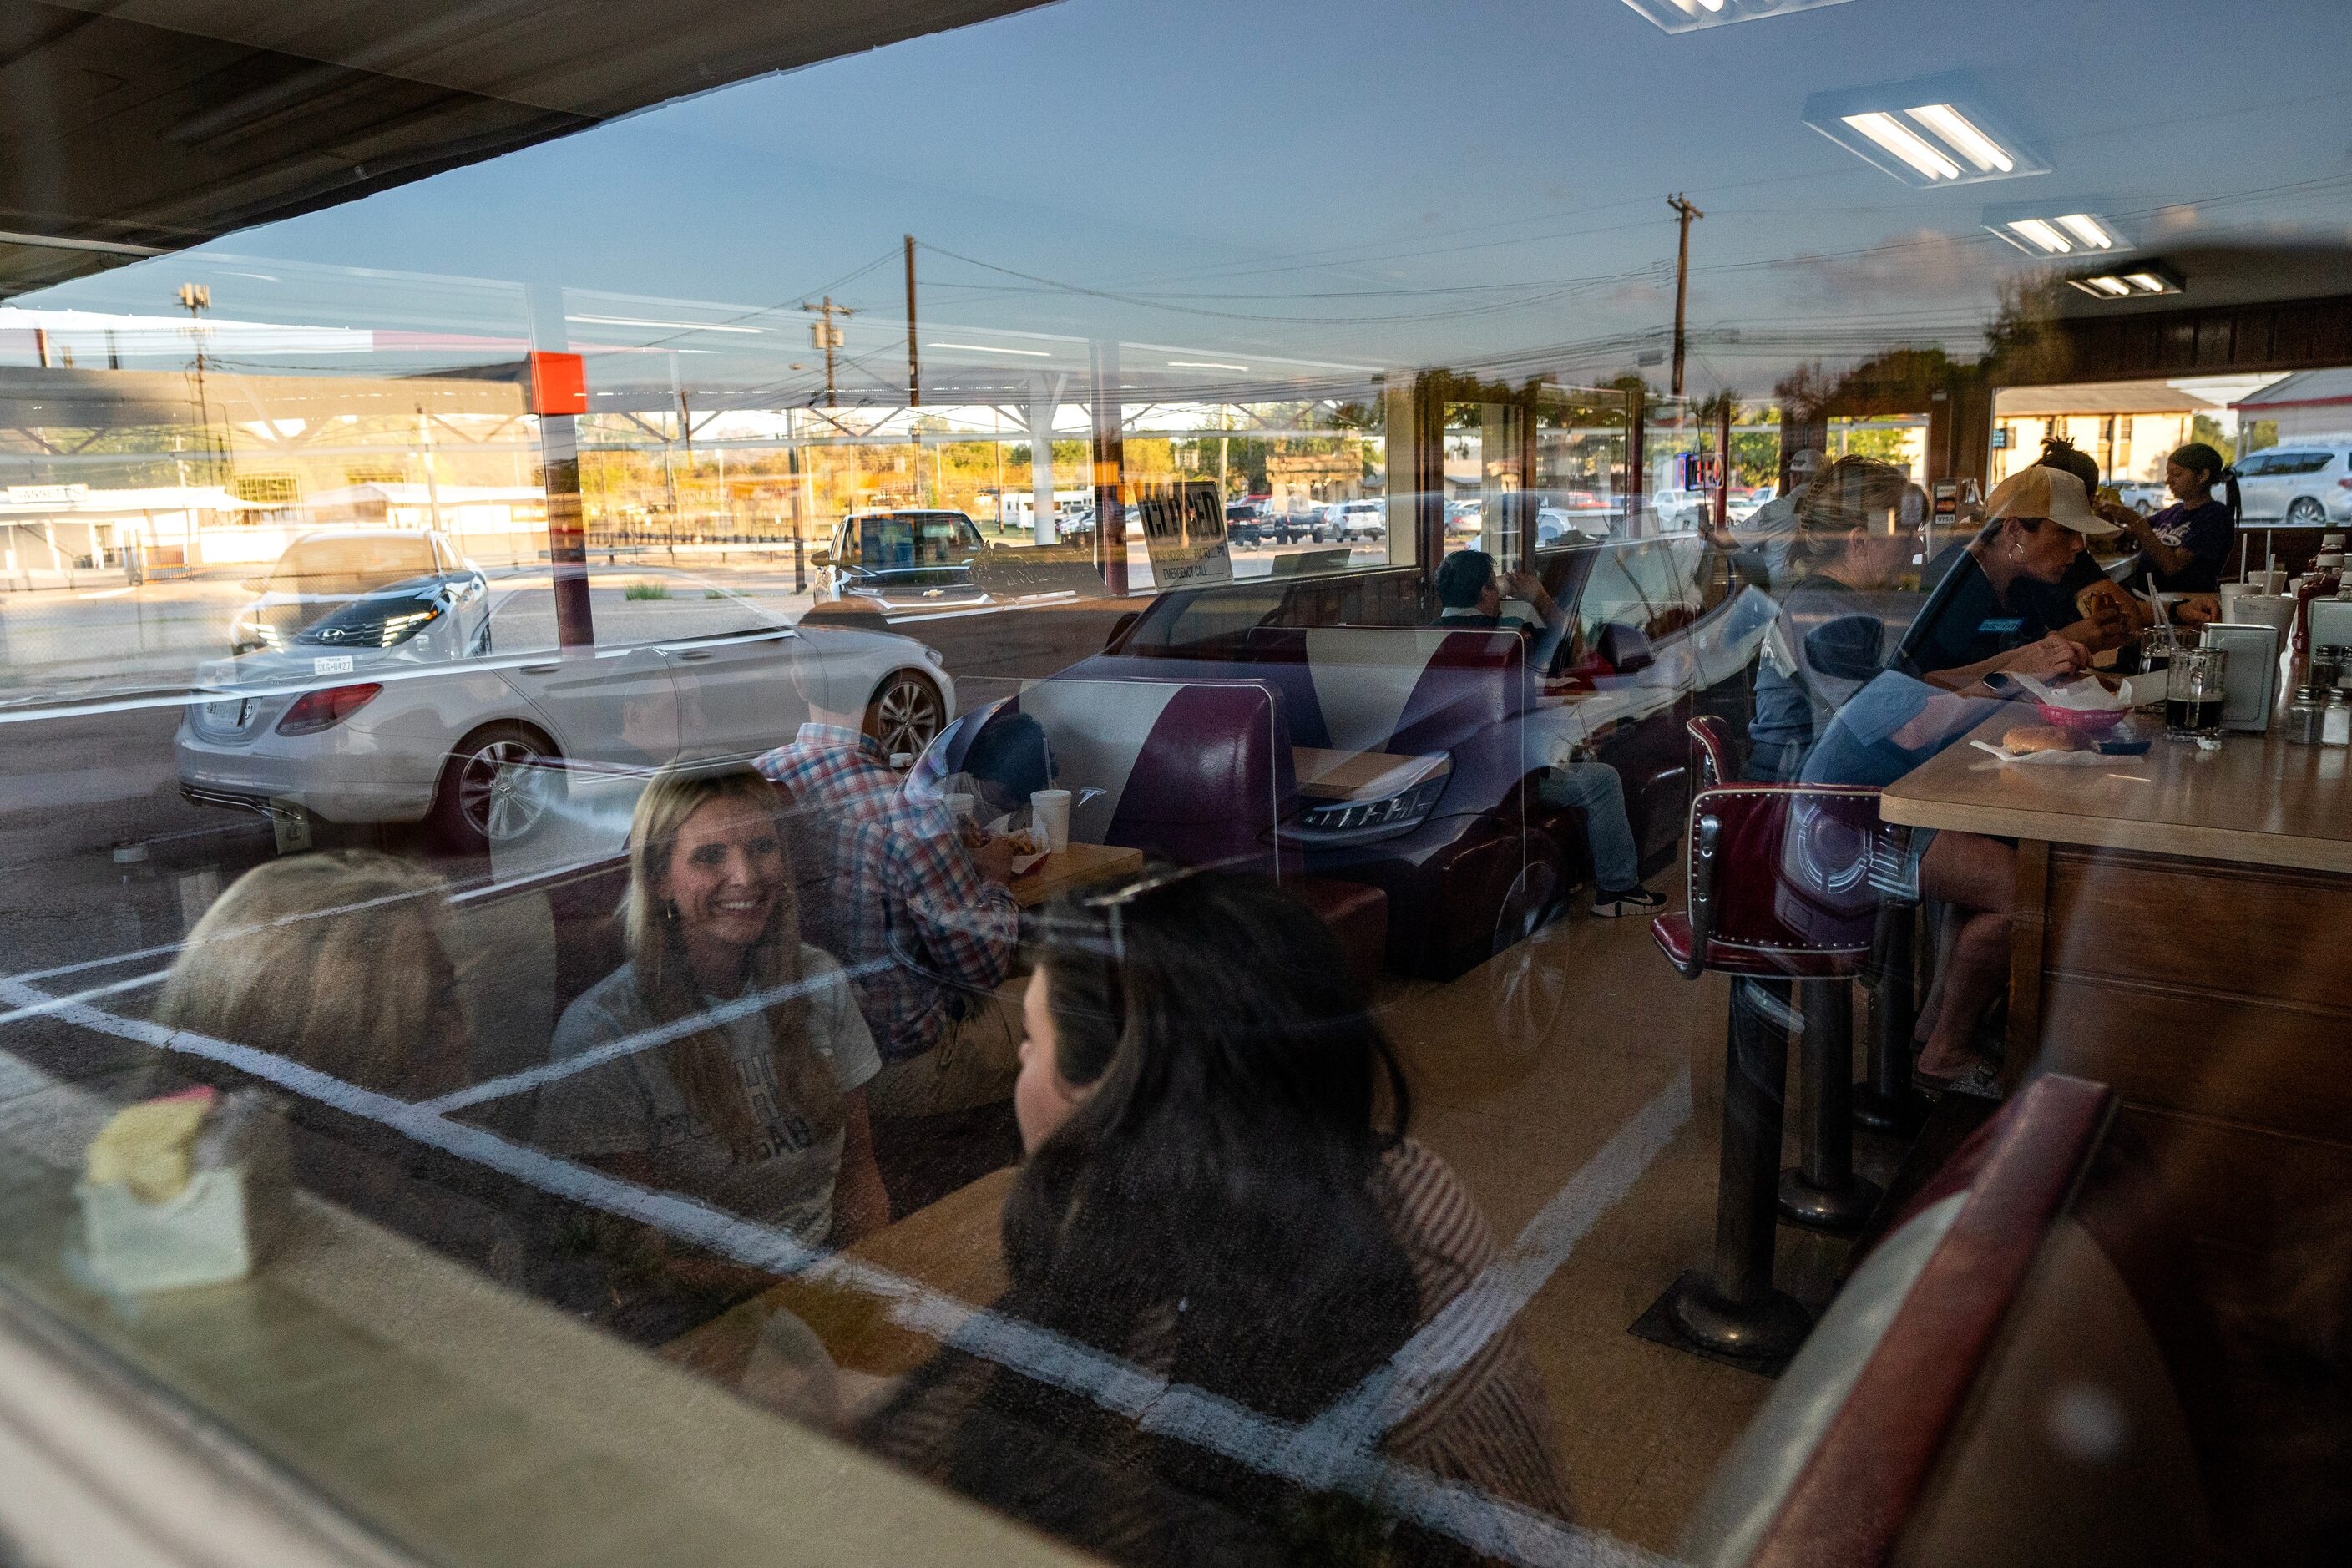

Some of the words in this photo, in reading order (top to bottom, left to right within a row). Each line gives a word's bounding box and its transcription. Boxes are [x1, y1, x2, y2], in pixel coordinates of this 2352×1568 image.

[1142, 491, 1222, 543] CLOSED
[1202, 546, 1211, 559] TO
[1216, 545, 1227, 557] PM
[1163, 566, 1194, 579] EMERGENCY
[1194, 564, 1207, 577] CALL
